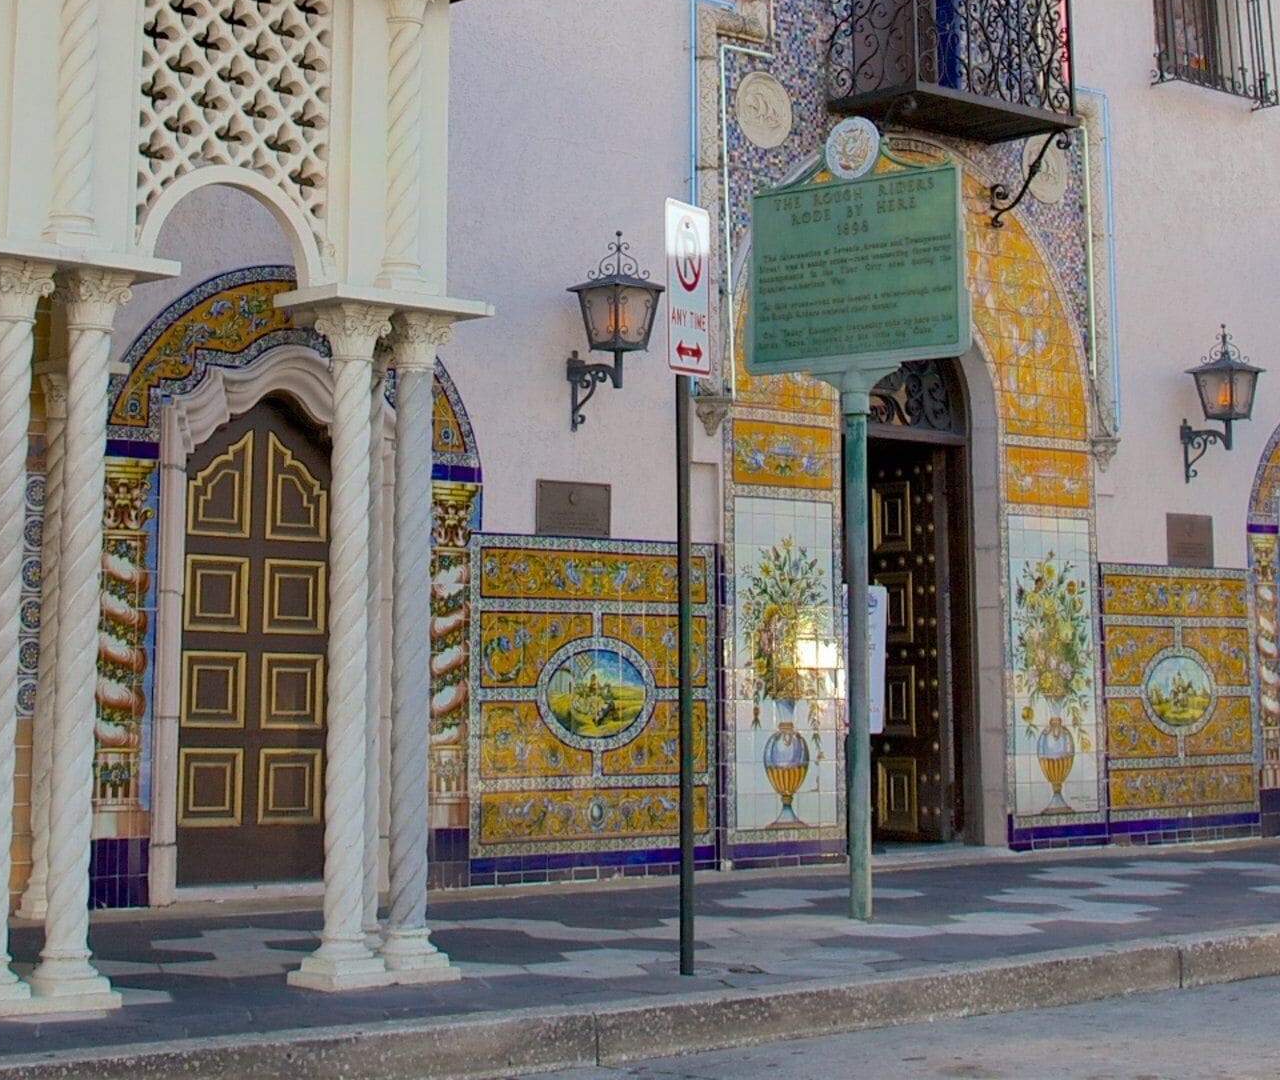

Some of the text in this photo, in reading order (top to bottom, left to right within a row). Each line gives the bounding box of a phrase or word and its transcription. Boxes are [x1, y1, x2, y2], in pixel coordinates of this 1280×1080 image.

[773, 176, 936, 212] THE ROUGH RIDERS
[791, 196, 918, 227] RODE BY HERE
[836, 220, 870, 237] 1898
[671, 307, 707, 333] ANY TIME
